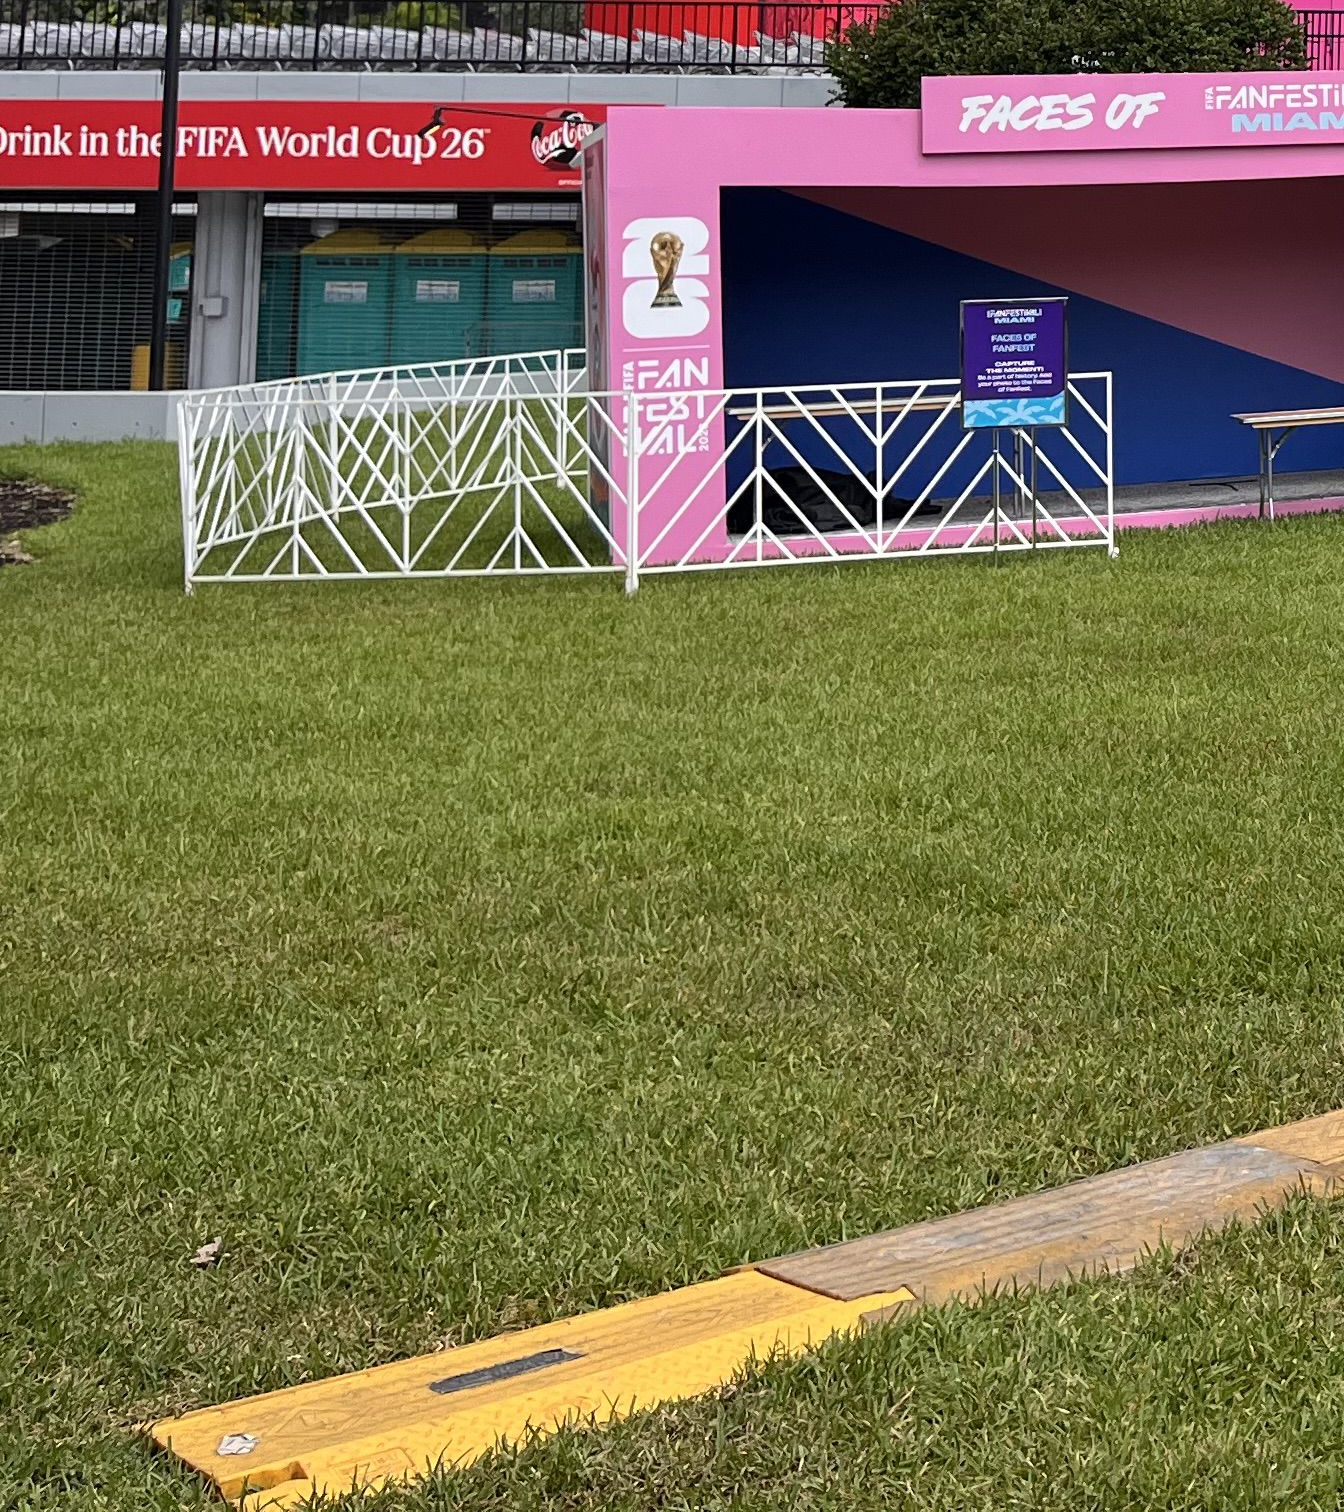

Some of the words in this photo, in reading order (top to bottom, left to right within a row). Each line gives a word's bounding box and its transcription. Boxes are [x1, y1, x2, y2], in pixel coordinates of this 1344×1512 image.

[958, 93, 1096, 133] FACES
[1105, 92, 1166, 130] OF
[1204, 86, 1214, 111] FIFA
[79, 125, 109, 156] in
[176, 126, 249, 157] FIFA
[256, 126, 359, 158] World
[366, 128, 438, 165] Cup
[991, 334, 1022, 342] FACES
[1024, 333, 1037, 341] OF
[637, 357, 709, 390] FAN
